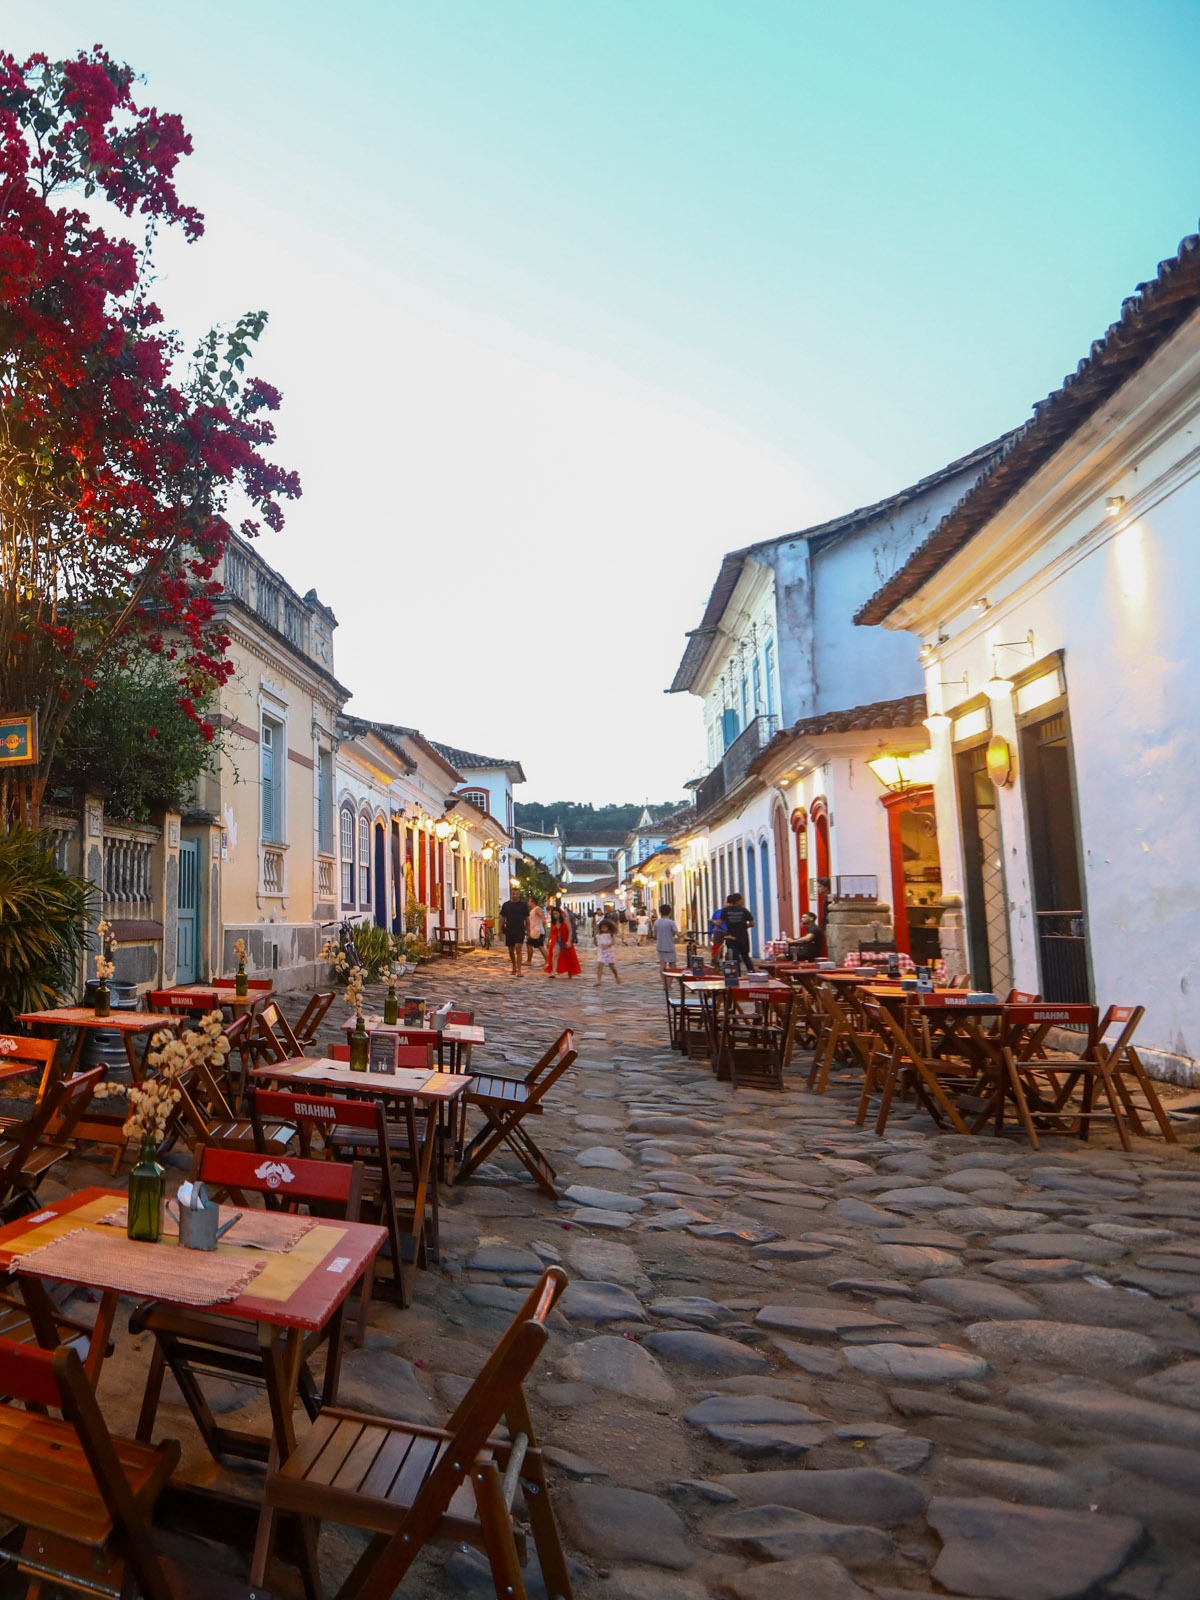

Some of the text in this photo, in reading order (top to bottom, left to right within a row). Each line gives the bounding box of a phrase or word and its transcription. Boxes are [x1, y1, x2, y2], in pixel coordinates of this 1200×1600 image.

[170, 996, 194, 1006] BRAHMA
[1033, 1011, 1070, 1021] BRAHMA
[294, 1102, 337, 1119] BRAHMA
